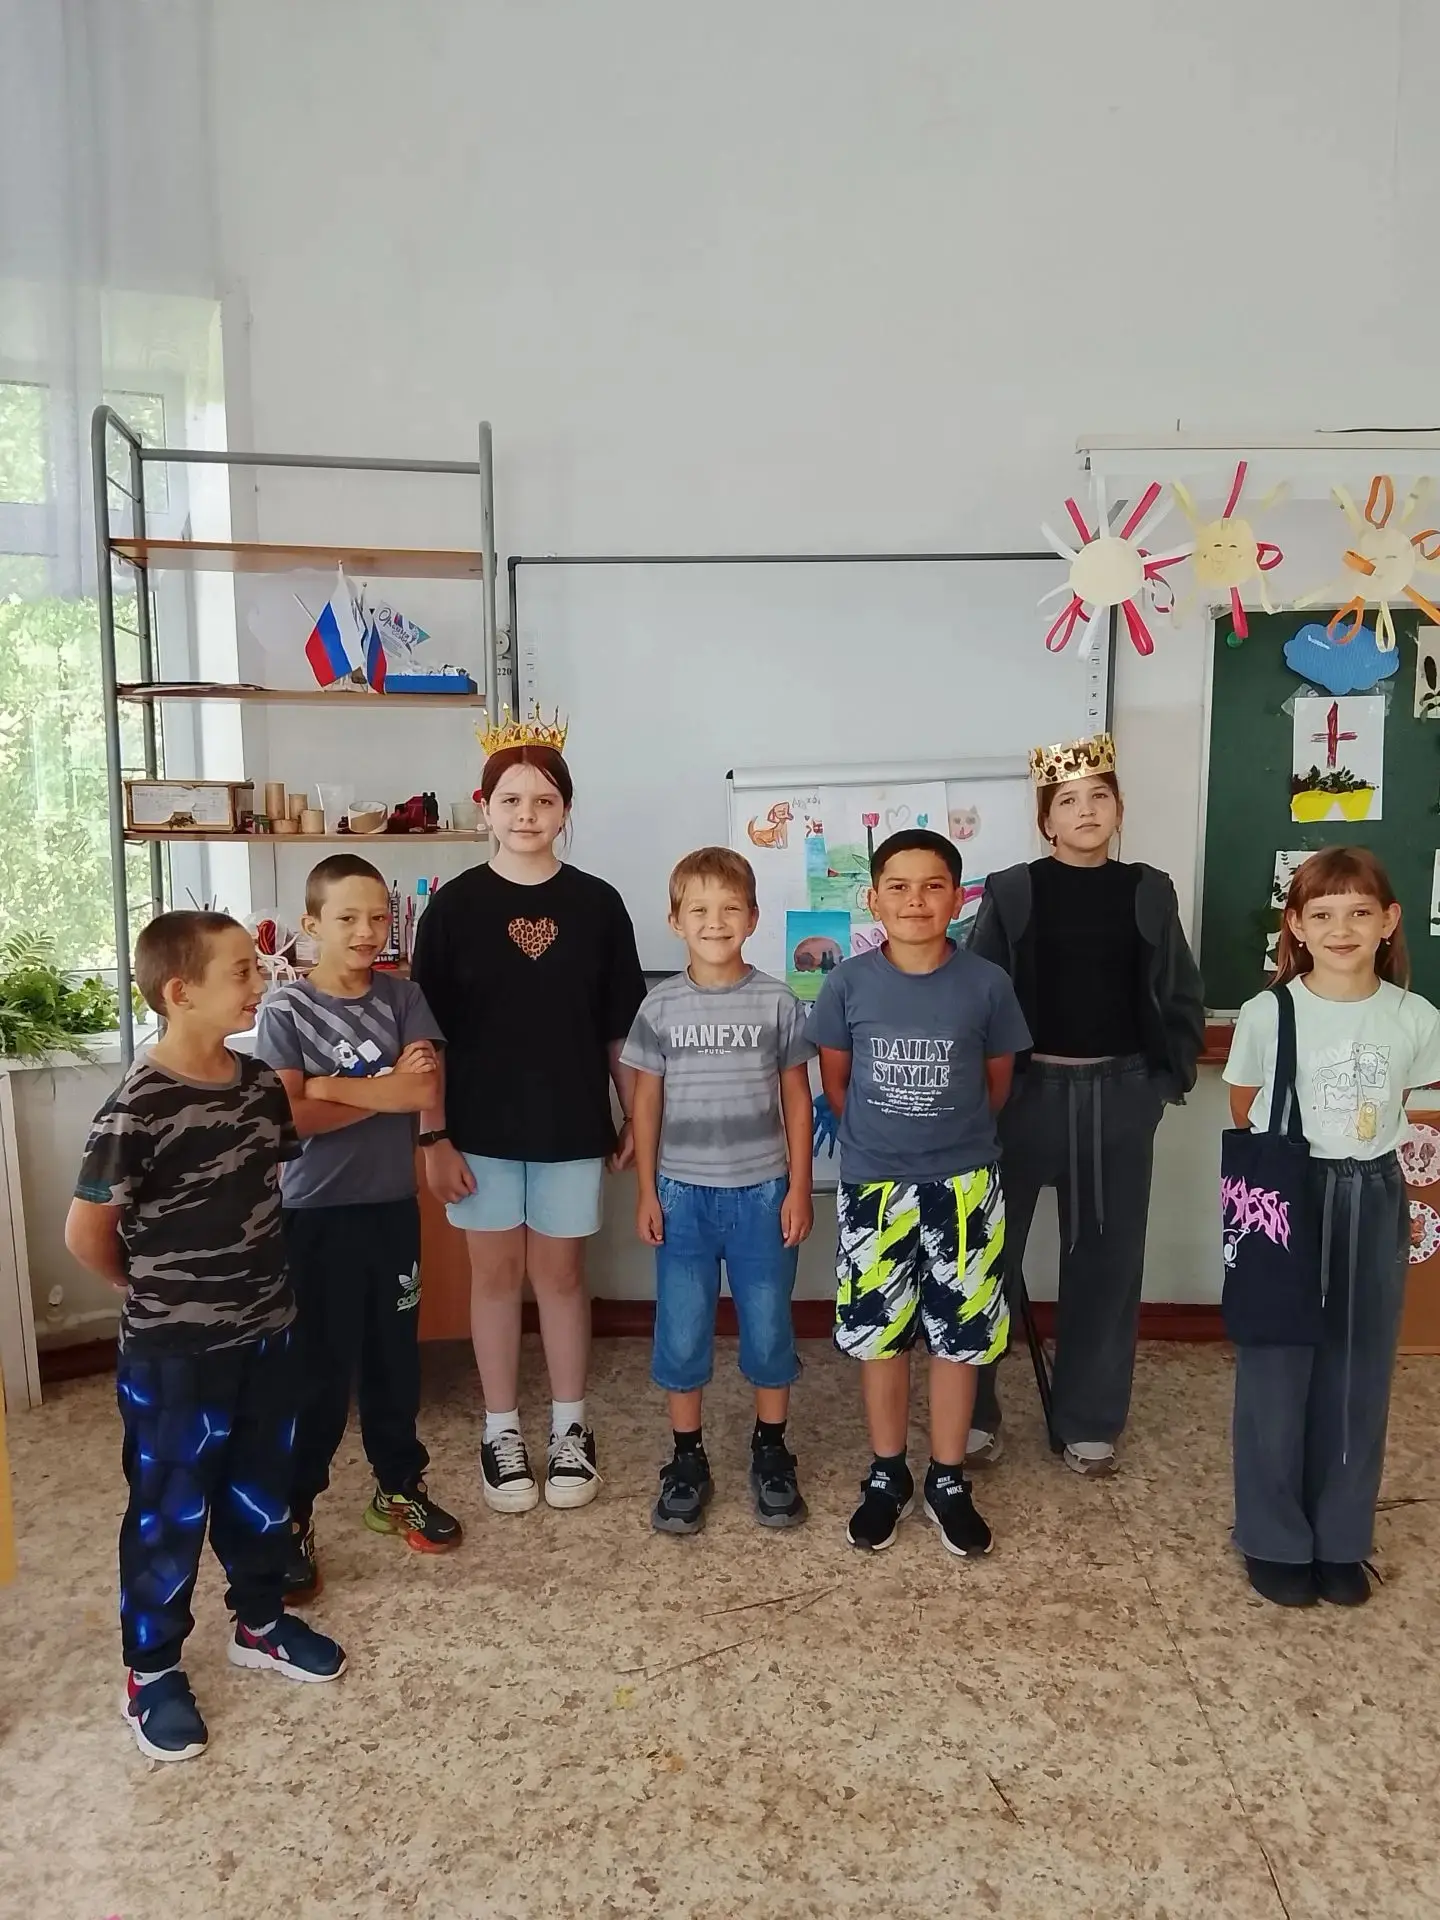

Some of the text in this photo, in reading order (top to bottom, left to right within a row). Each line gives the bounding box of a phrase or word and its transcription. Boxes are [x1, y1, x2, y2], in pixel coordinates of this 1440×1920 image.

[497, 668, 512, 676] 220
[670, 1024, 762, 1047] HANFXY
[870, 1037, 954, 1062] DAILY
[872, 1060, 950, 1088] STYLE
[871, 1480, 886, 1489] NIKE
[946, 1485, 963, 1495] NIKE
